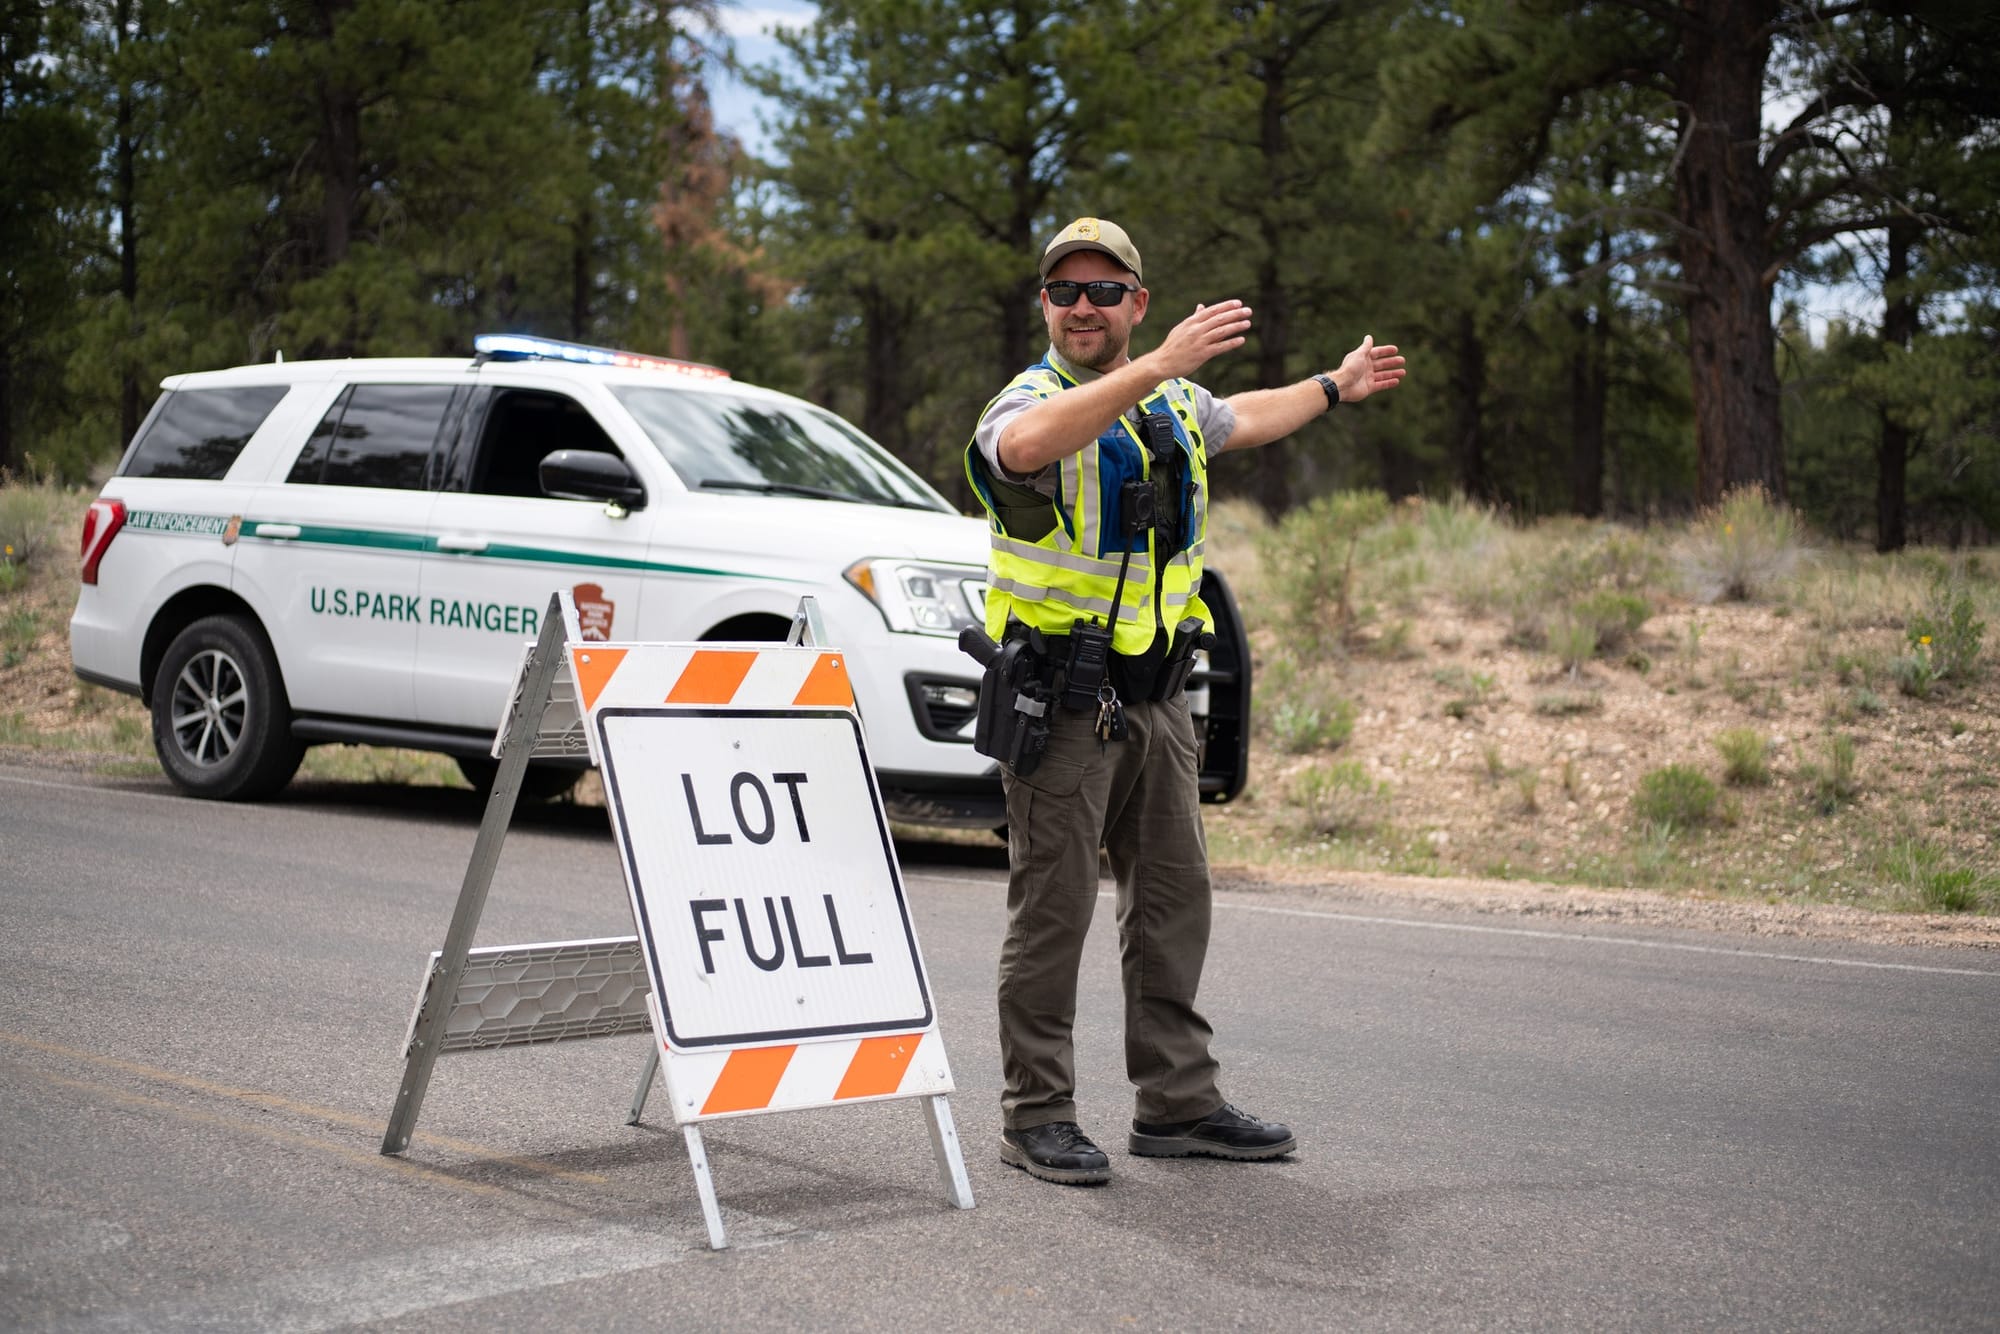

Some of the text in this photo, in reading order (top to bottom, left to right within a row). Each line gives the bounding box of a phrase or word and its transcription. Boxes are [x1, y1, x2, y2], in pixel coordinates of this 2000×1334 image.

[127, 510, 228, 534] LAW ENFORCEMENT
[430, 597, 539, 636] RANGER
[680, 771, 811, 845] LOT
[689, 893, 874, 975] FULL
